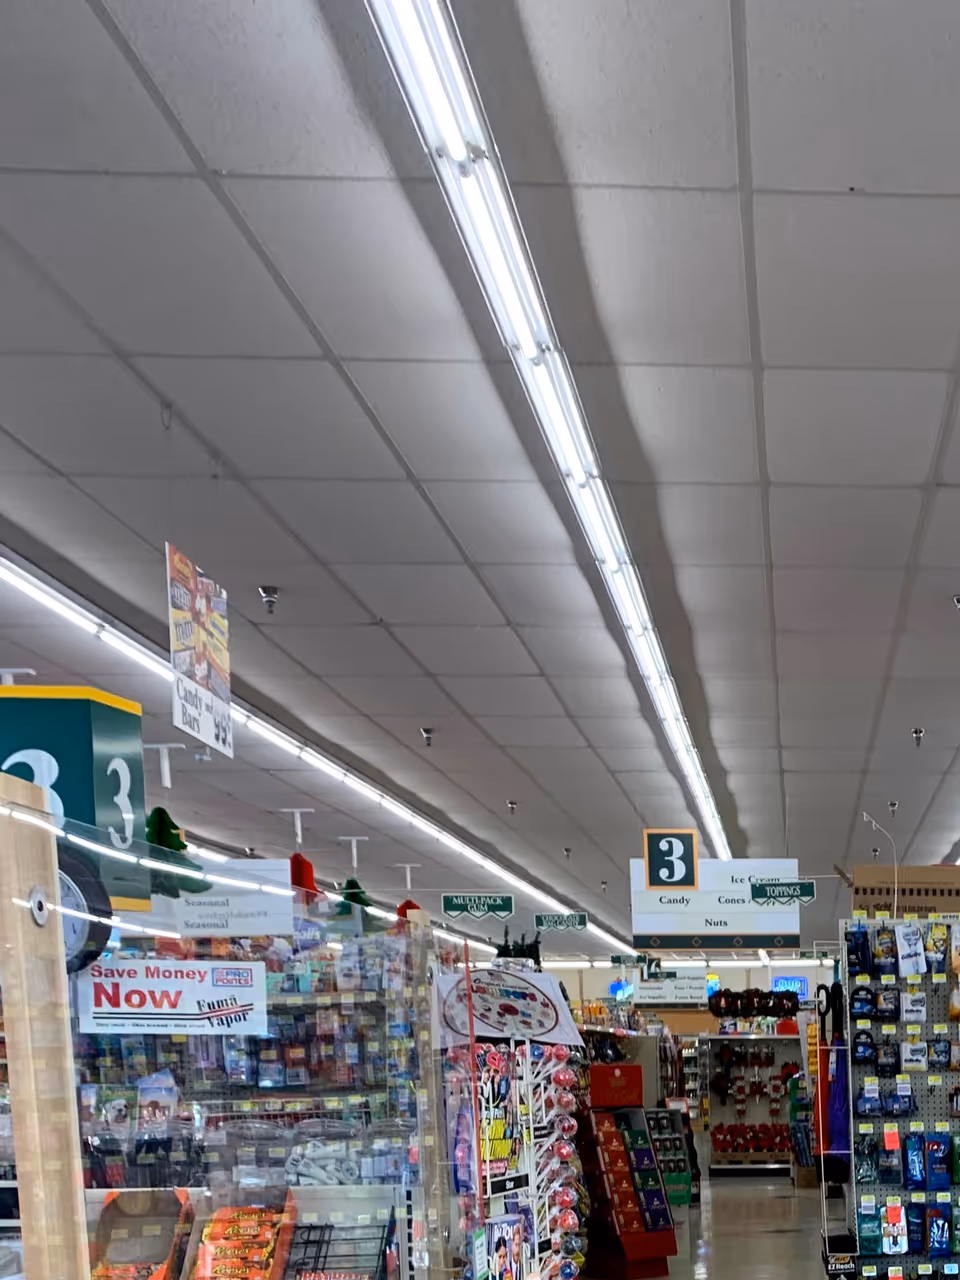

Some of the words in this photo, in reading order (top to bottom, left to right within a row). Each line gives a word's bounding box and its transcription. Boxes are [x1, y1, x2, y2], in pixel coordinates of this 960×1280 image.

[176, 677, 203, 716] Candy
[181, 702, 200, 735] Bars
[106, 757, 134, 850] 3
[658, 837, 687, 882] 3
[730, 875, 745, 884] Ice
[765, 885, 801, 896] TOPPINGS
[452, 896, 503, 905] MULTI-PACK
[659, 895, 691, 907] Candy
[717, 896, 746, 905] Cones
[467, 903, 488, 912] GUM
[184, 918, 229, 929] Seasonal
[704, 918, 728, 927] Nuts
[91, 965, 138, 980] Save
[144, 965, 208, 983] Money
[92, 981, 183, 1010] Now
[207, 1011, 250, 1029] Vapor
[836, 1262, 855, 1270] Reach
